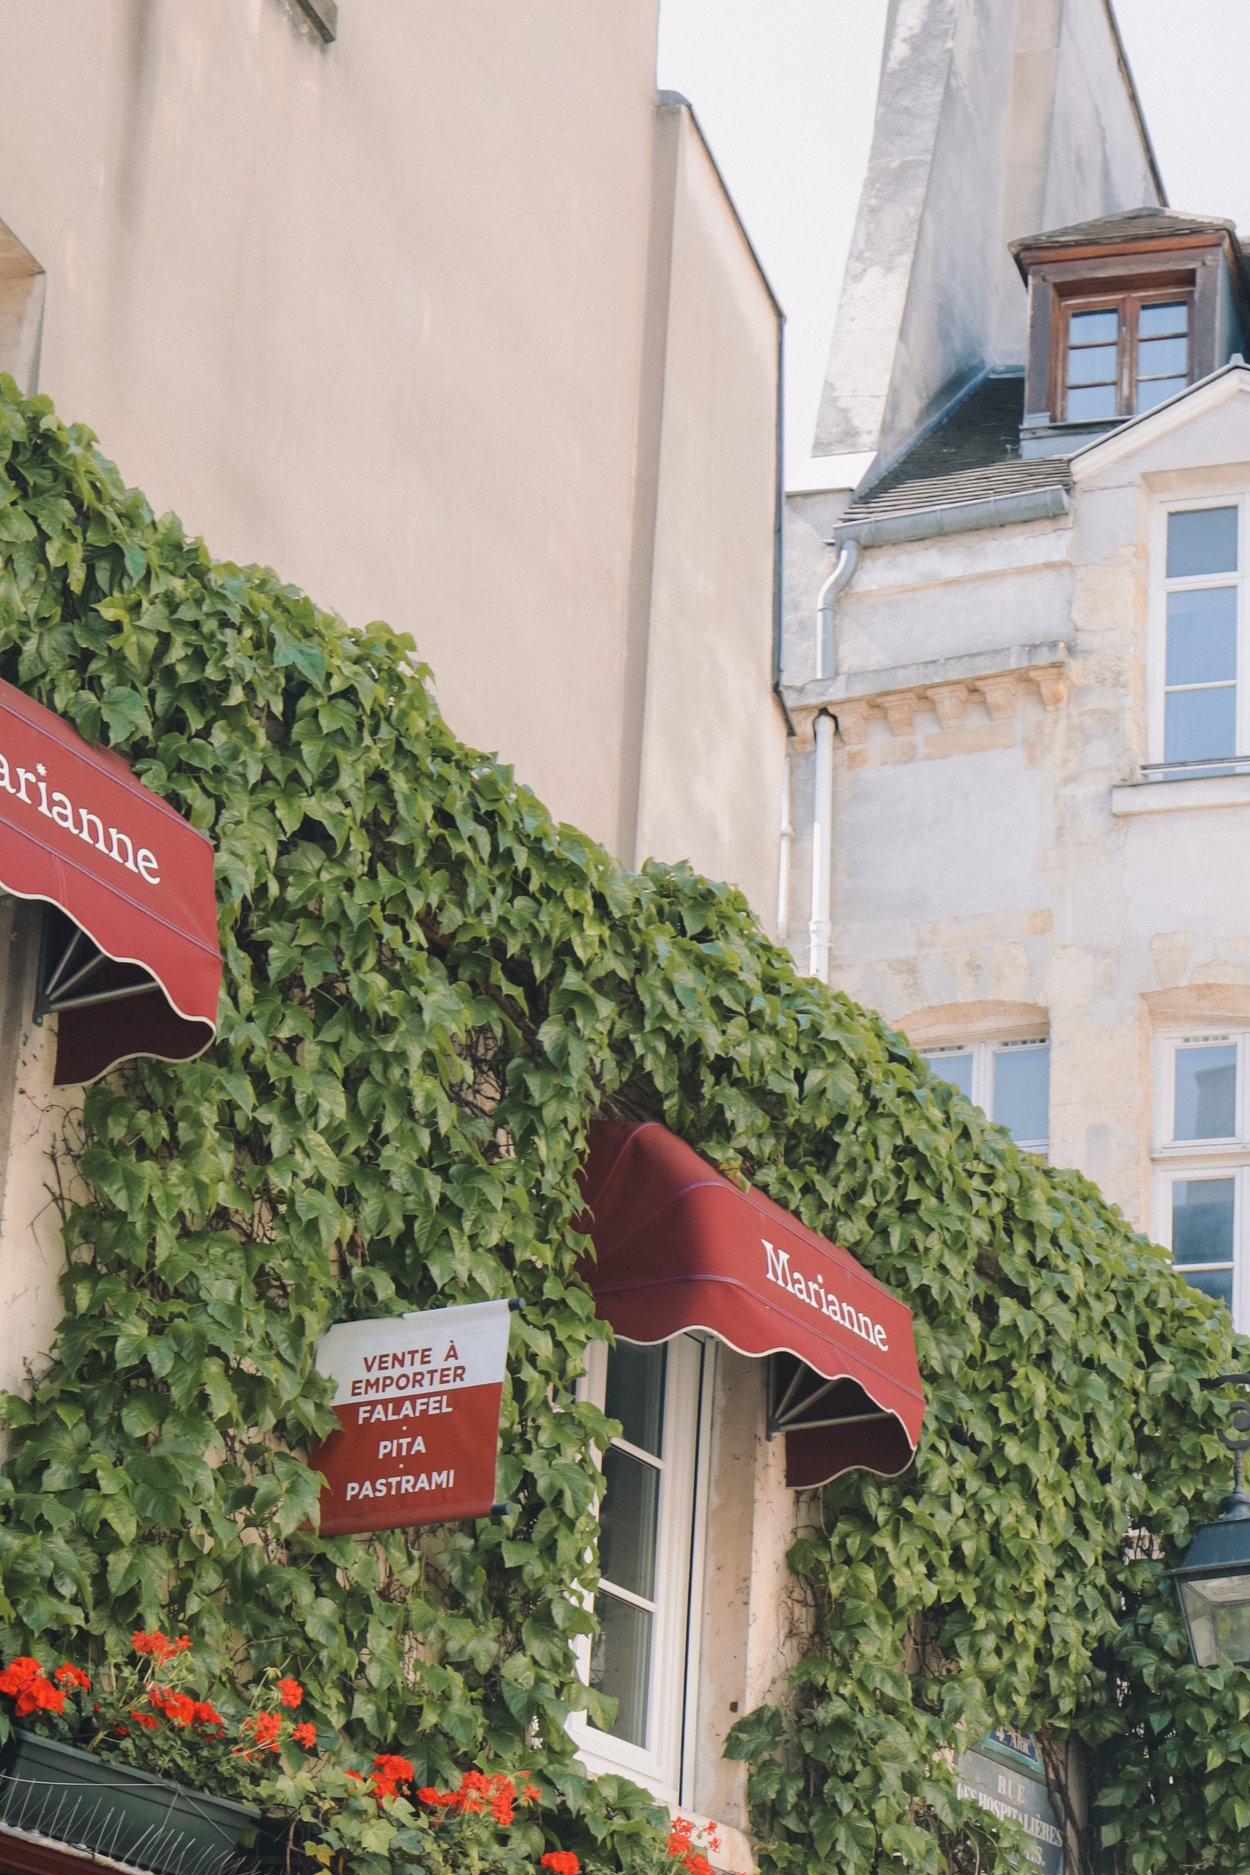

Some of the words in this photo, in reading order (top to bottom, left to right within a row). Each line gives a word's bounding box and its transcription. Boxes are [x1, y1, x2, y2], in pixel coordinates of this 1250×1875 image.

[0, 752, 160, 885] arianne
[761, 1238, 888, 1352] Marianne
[363, 1347, 432, 1373] VENTE
[444, 1340, 459, 1362] À
[351, 1365, 466, 1397] EMPORTER
[358, 1395, 453, 1425] FALAFEL
[378, 1436, 426, 1459] PITA
[346, 1469, 455, 1501] PASTRAMI
[997, 1774, 1025, 1804] RUE
